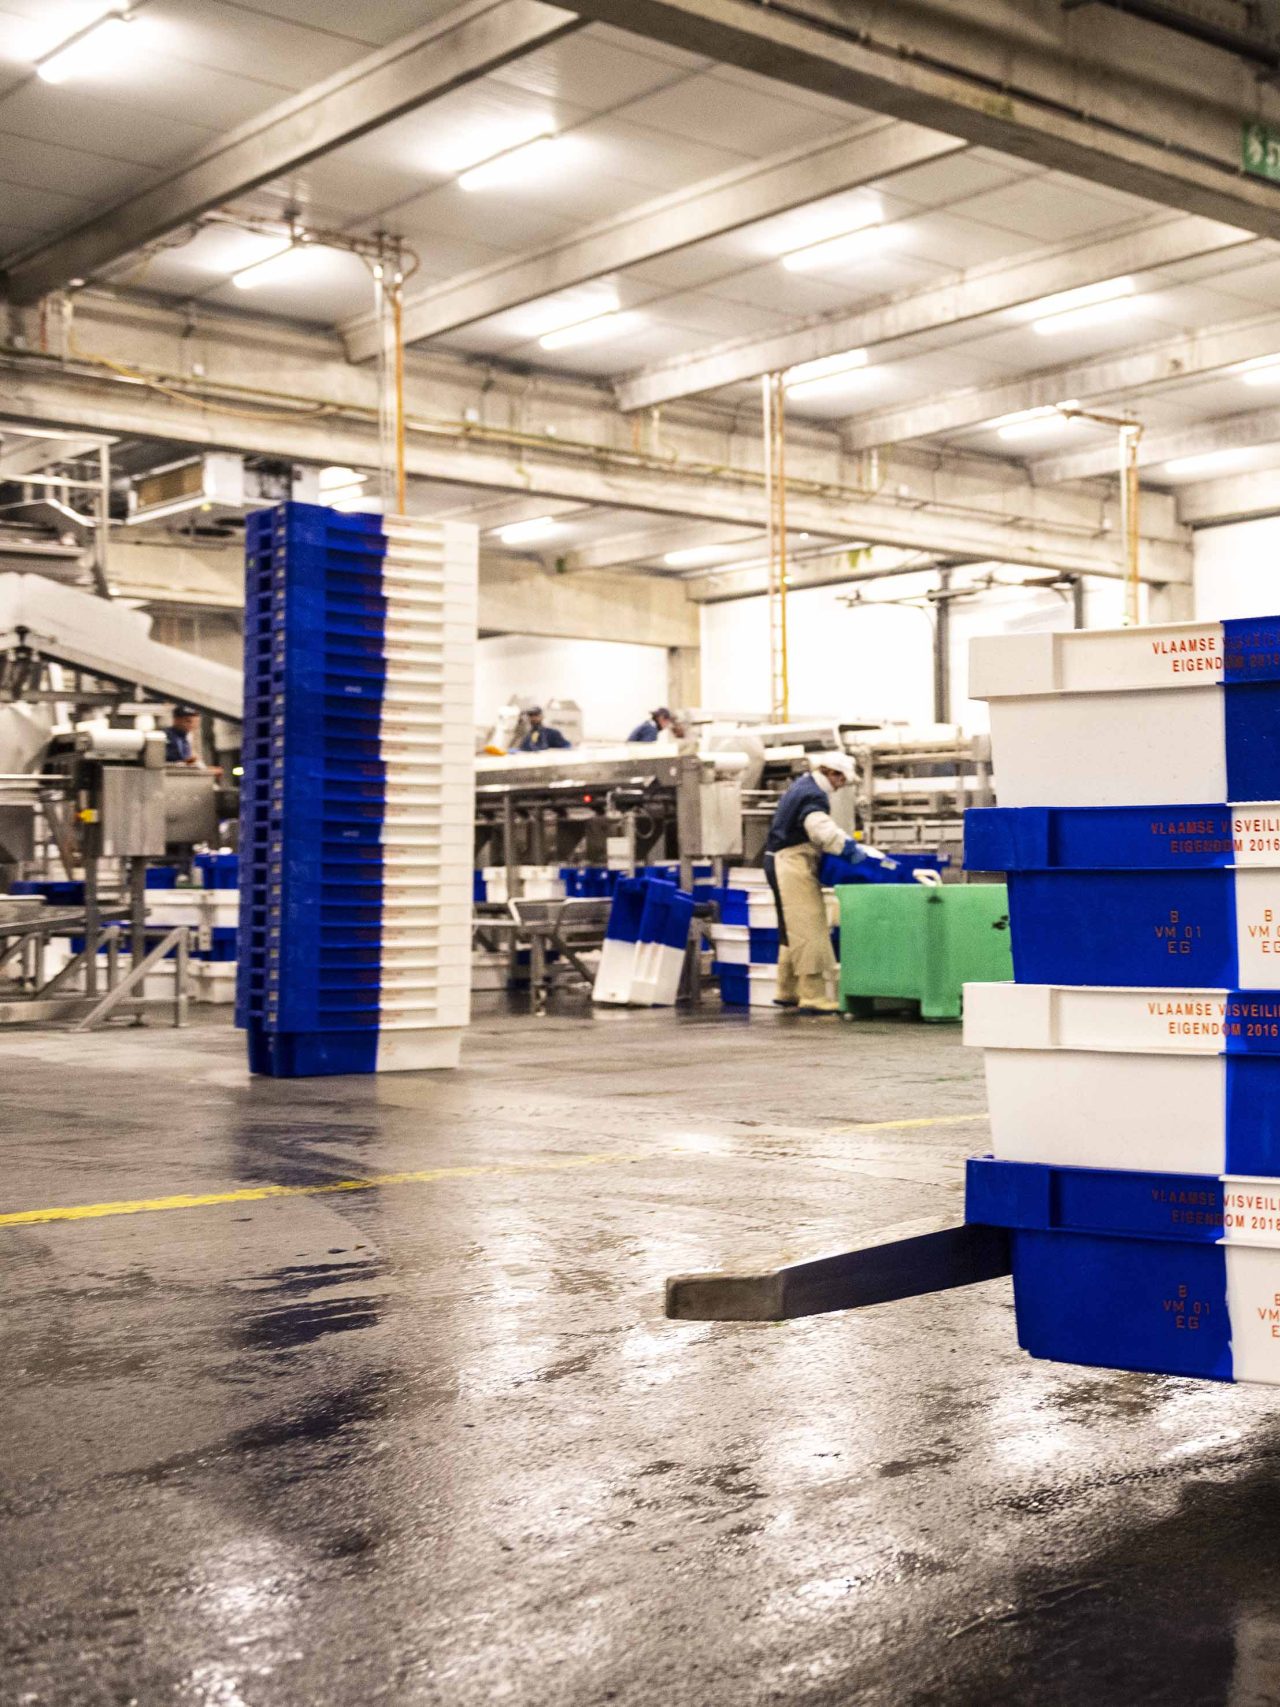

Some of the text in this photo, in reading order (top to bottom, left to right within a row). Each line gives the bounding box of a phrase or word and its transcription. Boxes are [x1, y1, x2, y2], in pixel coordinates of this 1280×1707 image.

[1152, 637, 1216, 654] VLAAMSE
[1172, 654, 1245, 673] EIGENDOM
[1151, 820, 1215, 835] VLAAMSE
[1170, 837, 1280, 853] EIGENDOM 2016
[1170, 910, 1179, 923] B
[1264, 909, 1273, 922] B
[1154, 926, 1177, 938] VM
[1248, 925, 1270, 938] VM
[1167, 941, 1191, 954] EG
[1147, 1002, 1212, 1016] VLAAMSE
[1168, 1021, 1279, 1037] EIGENDOM 2016
[1151, 1189, 1216, 1206] VLAAMSE
[1171, 1209, 1245, 1228] EIGENDOM
[1178, 1284, 1187, 1297] B
[1163, 1300, 1185, 1312] VM
[1257, 1307, 1280, 1321] VM
[1175, 1315, 1199, 1329] EG
